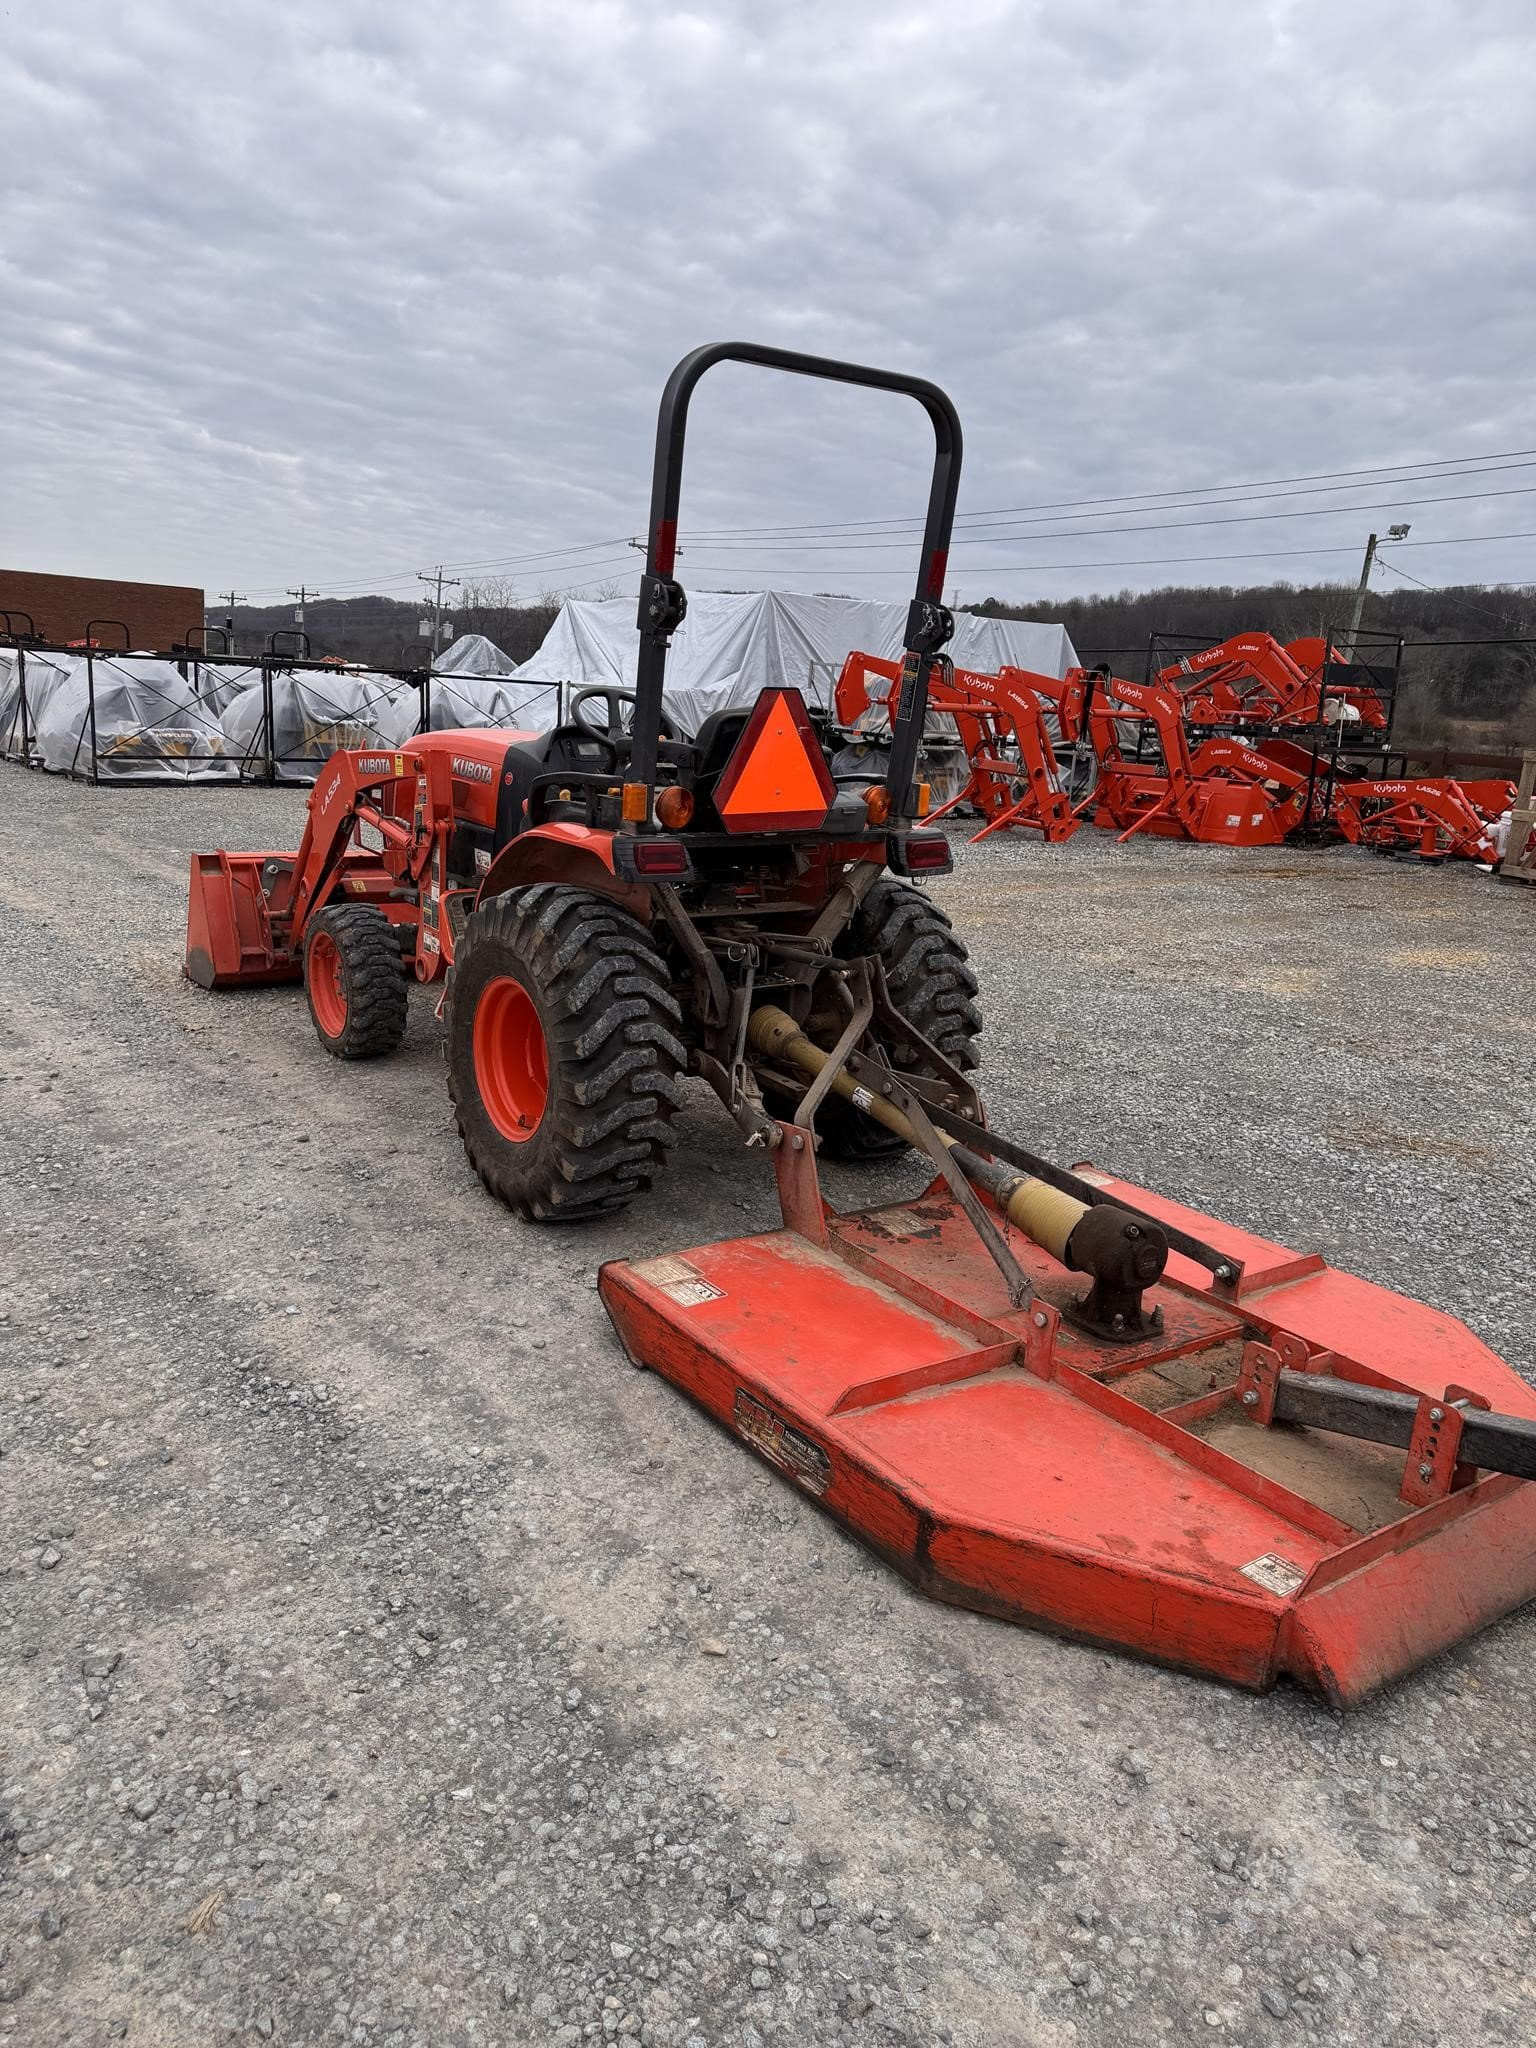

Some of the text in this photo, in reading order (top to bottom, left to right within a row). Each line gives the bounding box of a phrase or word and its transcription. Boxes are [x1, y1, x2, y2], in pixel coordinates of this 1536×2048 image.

[1197, 649, 1224, 663] Kubota
[963, 673, 995, 692] Kubota
[1117, 682, 1143, 699] Kubota
[358, 758, 391, 774] KUBOTA
[1242, 752, 1268, 771] Kubota
[452, 758, 493, 784] KUBOTA
[320, 772, 341, 815] LA534
[1373, 783, 1407, 793] Kubota
